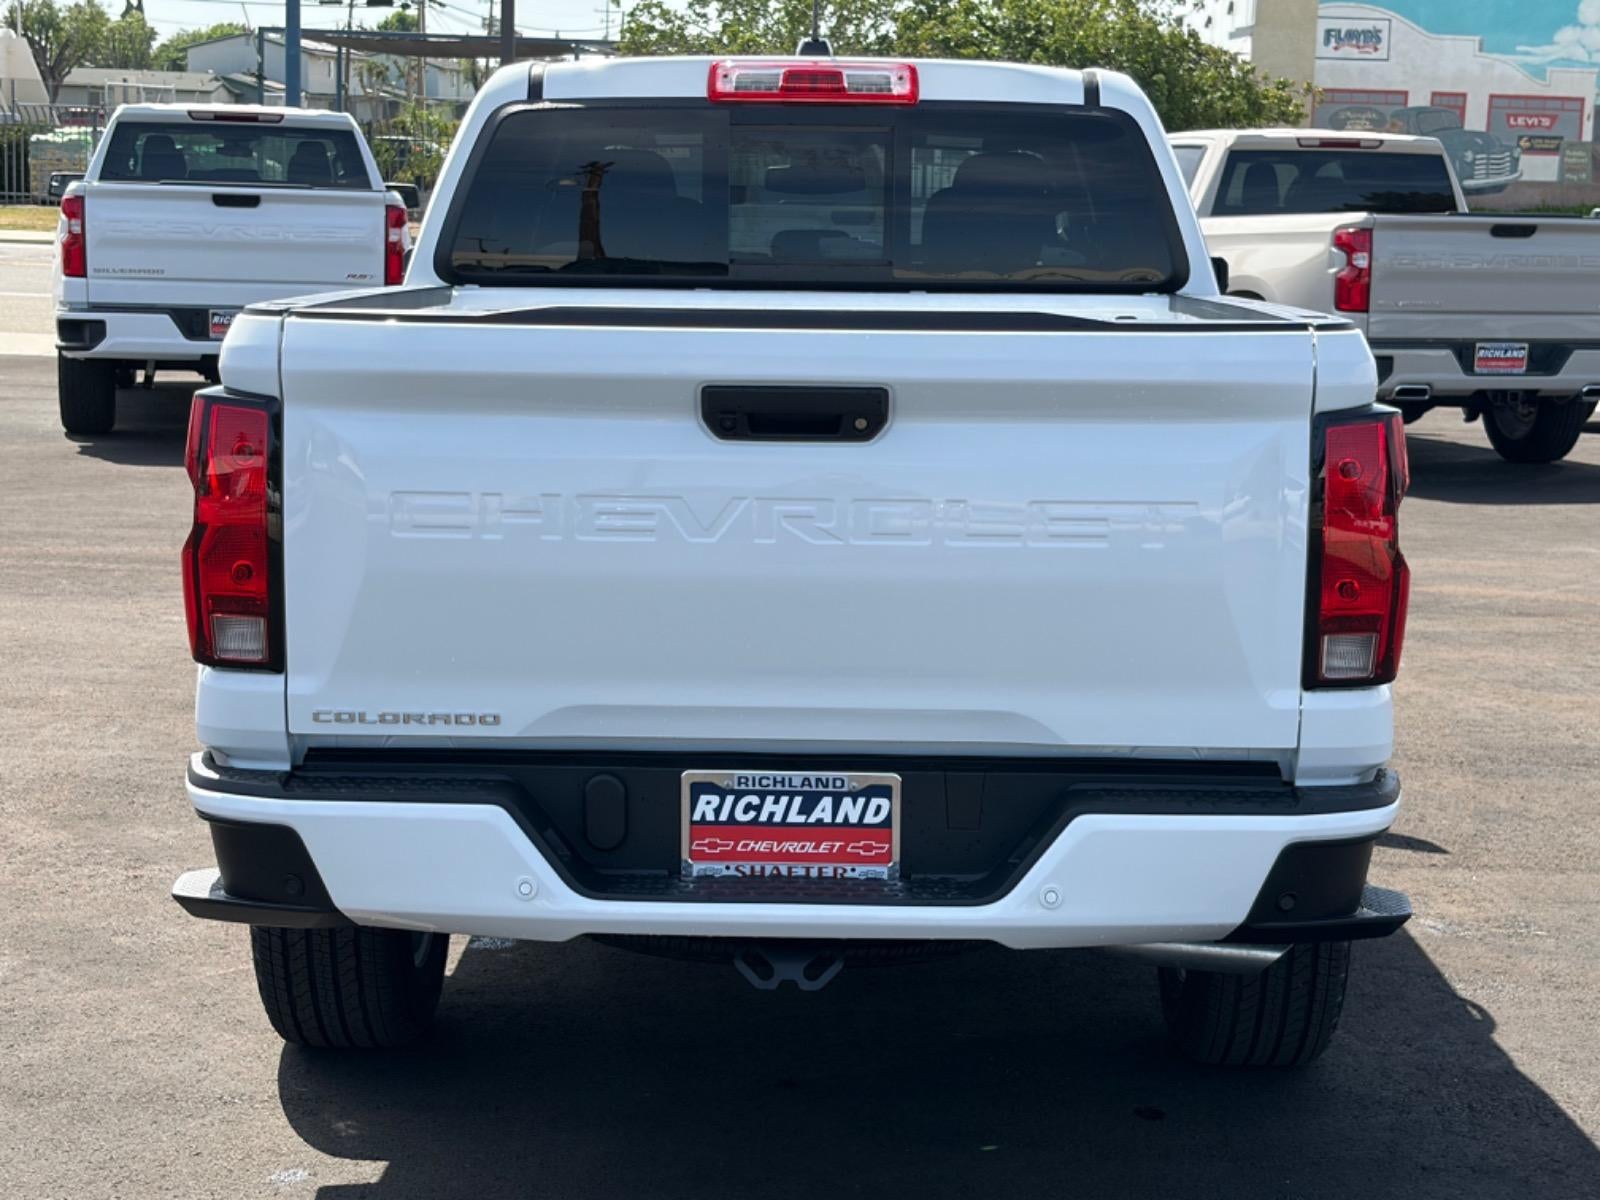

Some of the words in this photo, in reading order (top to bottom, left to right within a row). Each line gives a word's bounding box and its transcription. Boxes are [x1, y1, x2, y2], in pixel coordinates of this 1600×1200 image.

[390, 491, 1199, 549] CHEVROLET
[312, 709, 501, 726] COLORADO
[736, 775, 846, 790] RICHLAND
[692, 794, 891, 825] RICHLAND
[736, 840, 845, 854] CHEVROLET
[735, 864, 848, 880] SHAFTER
